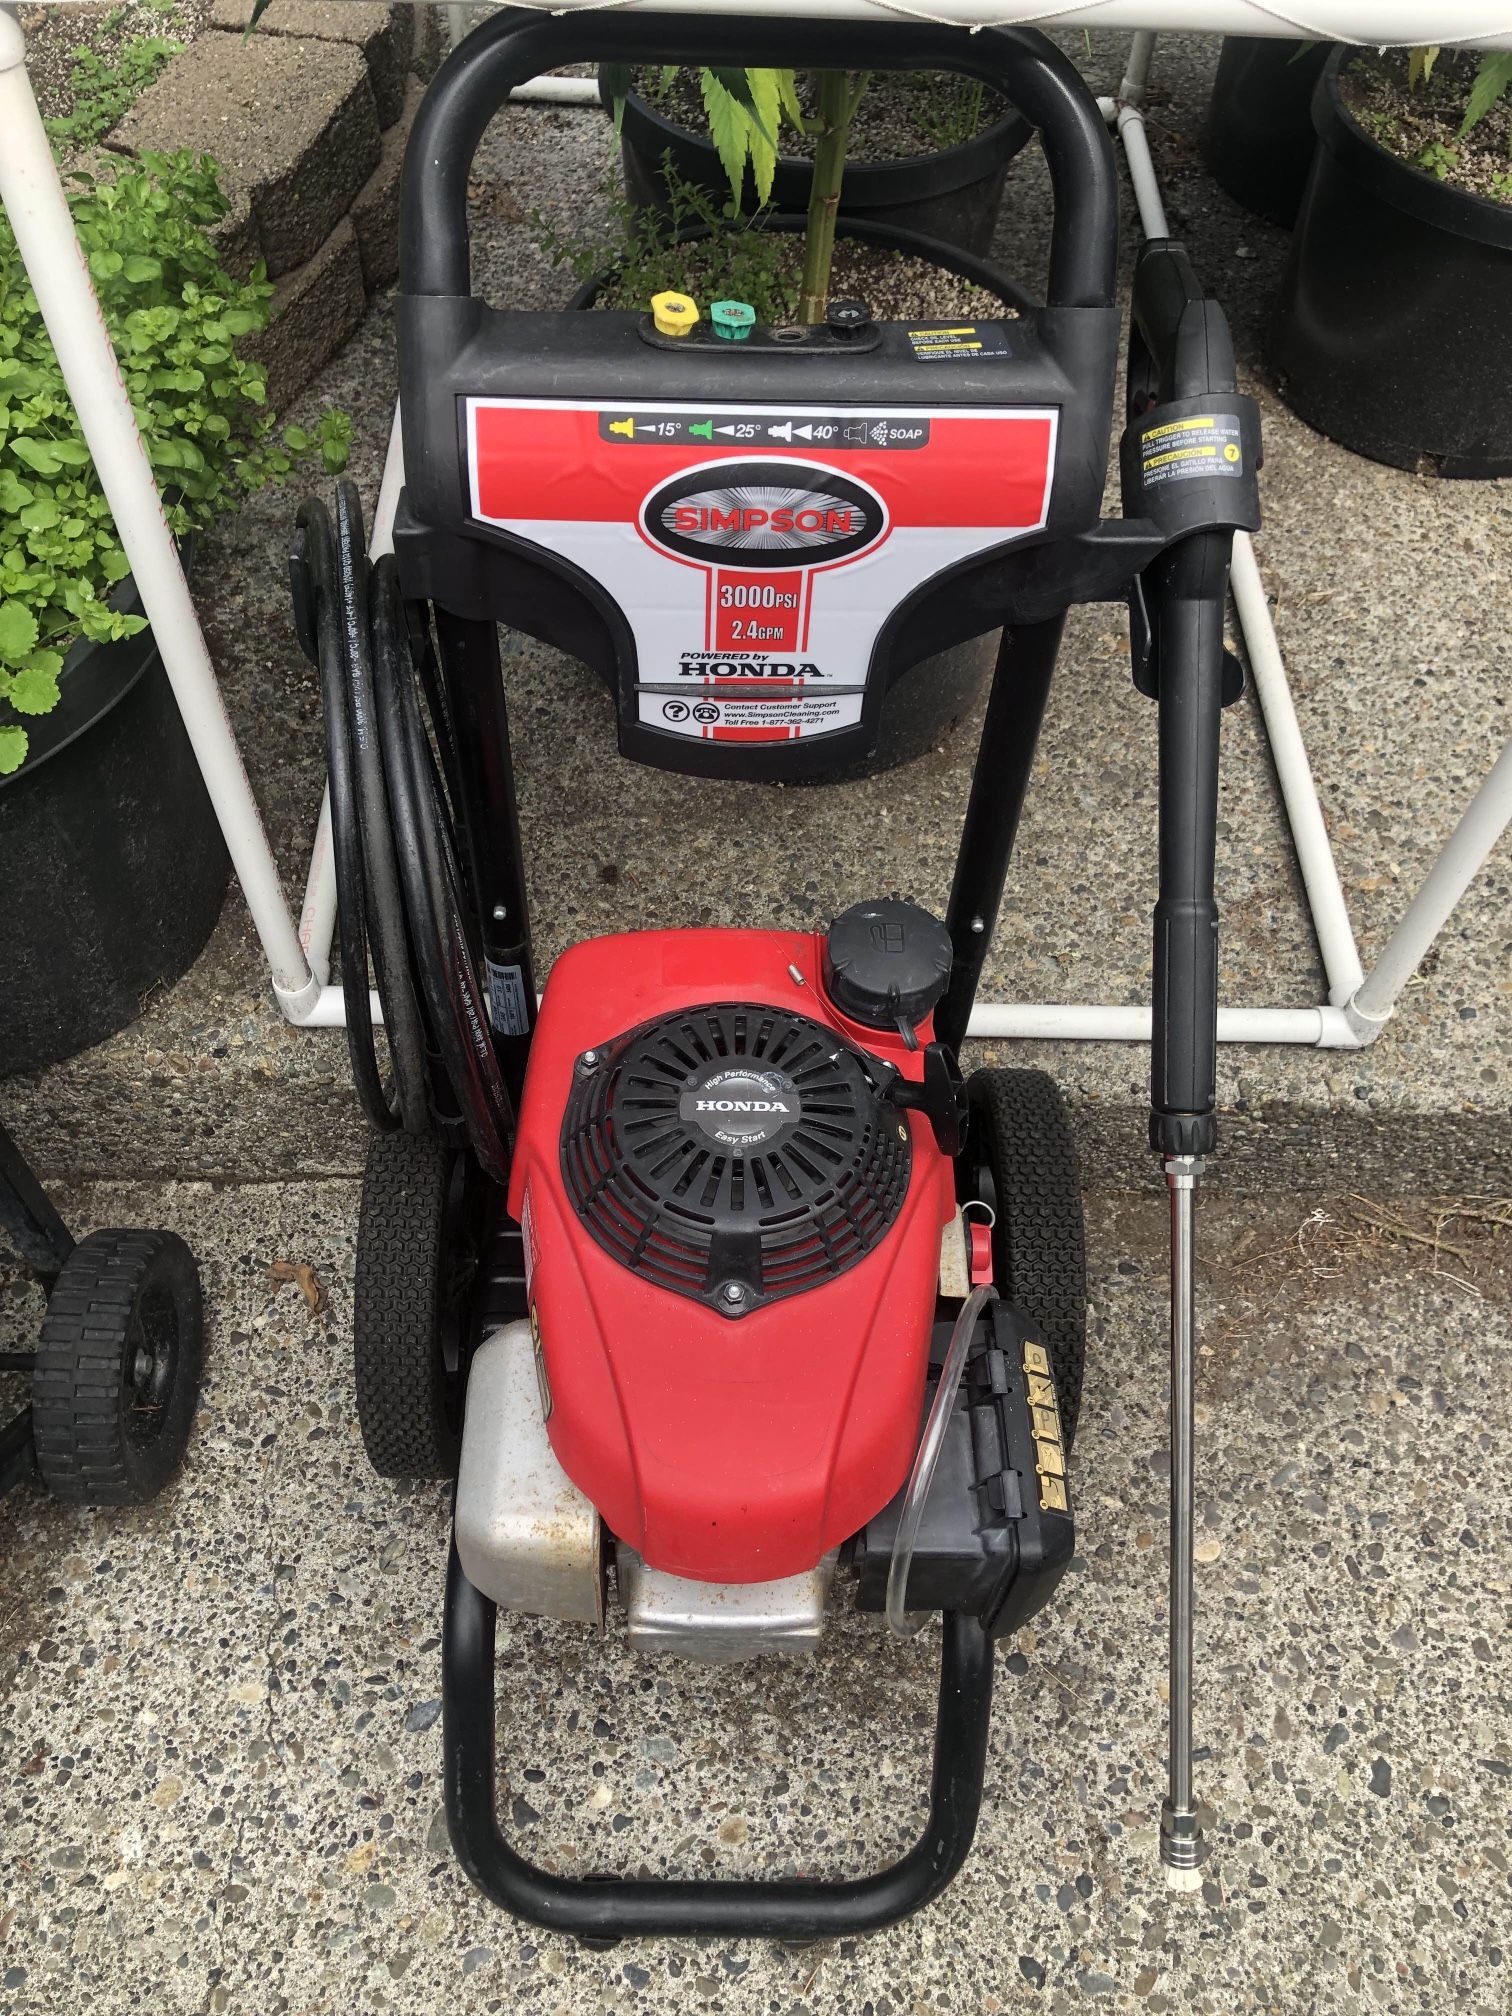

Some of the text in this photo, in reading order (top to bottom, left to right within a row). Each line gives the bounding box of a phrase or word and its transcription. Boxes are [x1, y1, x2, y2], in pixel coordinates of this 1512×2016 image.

[656, 422, 682, 436] 15°
[735, 423, 761, 438] 25°
[813, 425, 839, 439] 40°
[889, 428, 923, 440] SOAP
[1152, 424, 1184, 438] CAUTION
[1142, 442, 1154, 450] PULL
[1156, 434, 1180, 446] TRIGGER
[1191, 428, 1219, 437] RELEASE
[1220, 428, 1239, 437] WATER
[1142, 443, 1170, 457] PRESSURE
[1172, 438, 1196, 448] BEFORE
[1228, 449, 1236, 458] 7
[1153, 448, 1203, 465] PRECAUCIÓN
[1144, 466, 1170, 478] PRESIONE
[1181, 458, 1205, 467] GATILLO
[1144, 473, 1167, 486] LIBERAR
[674, 506, 852, 533] SIMPSON
[681, 652, 769, 662] POWERED by
[679, 662, 825, 678] HONDA
[803, 702, 837, 710] Support
[724, 709, 840, 719] www.SimpsonCleaning.com
[761, 717, 824, 726] 1-877-362-4271
[704, 1070, 776, 1092] High Performance
[696, 1100, 790, 1113] HONDA
[715, 1130, 766, 1145] Easy Start
